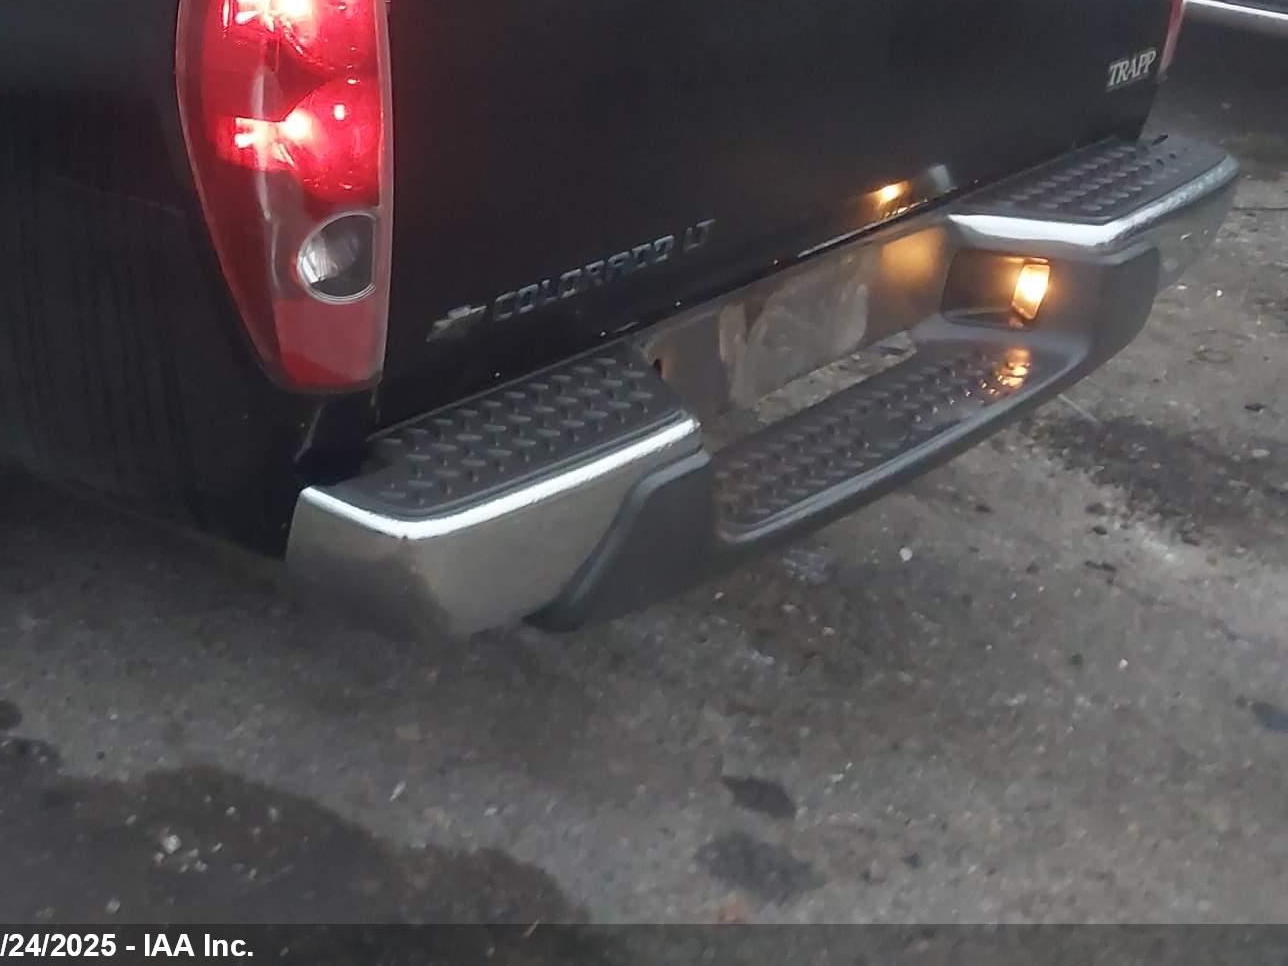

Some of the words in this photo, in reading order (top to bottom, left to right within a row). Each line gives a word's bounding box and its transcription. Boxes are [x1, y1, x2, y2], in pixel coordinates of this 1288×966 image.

[1107, 49, 1157, 86] TRAPP
[492, 234, 675, 322] COLORADO
[682, 218, 716, 253] LT
